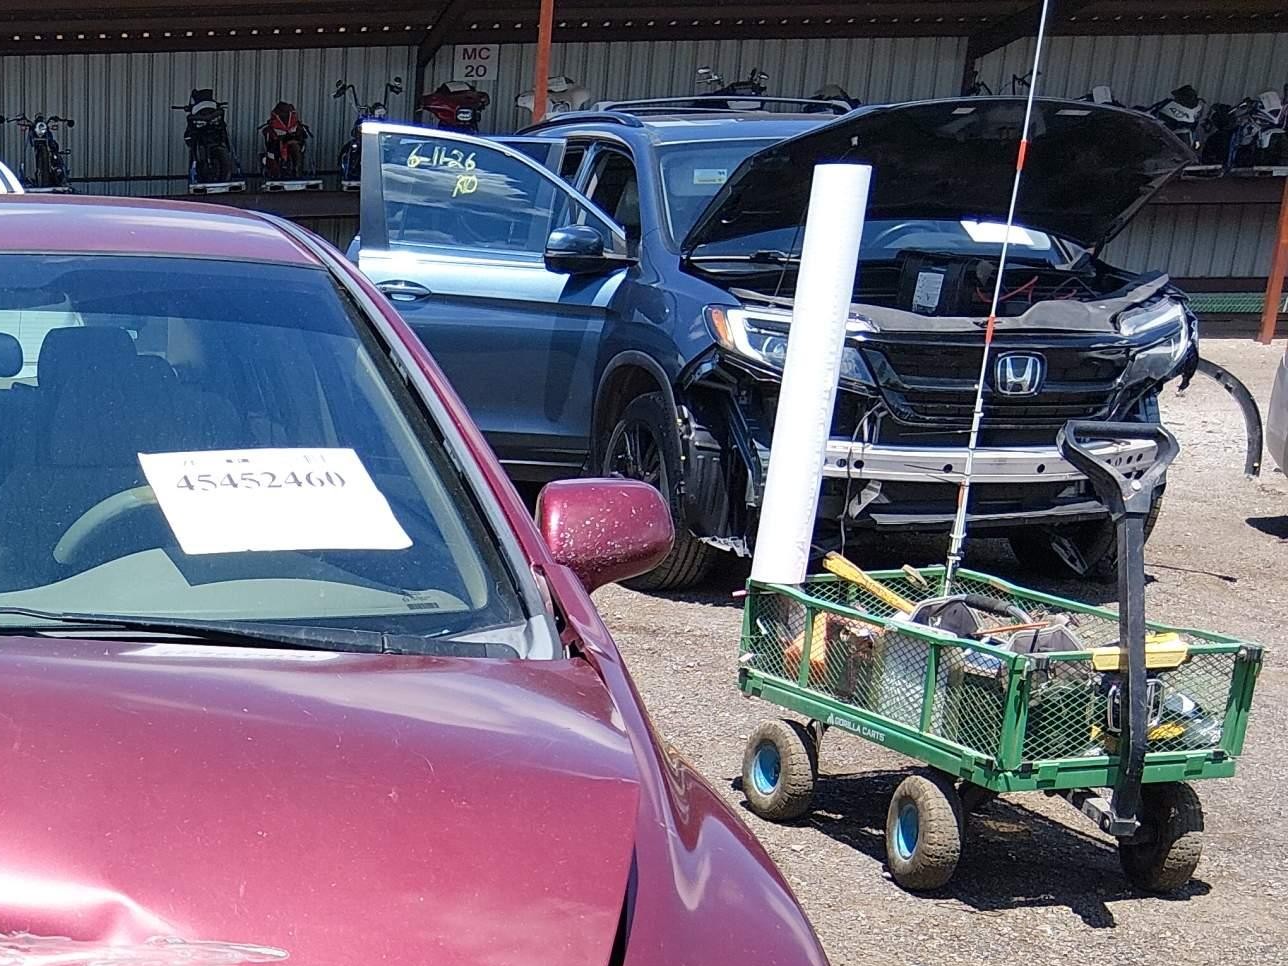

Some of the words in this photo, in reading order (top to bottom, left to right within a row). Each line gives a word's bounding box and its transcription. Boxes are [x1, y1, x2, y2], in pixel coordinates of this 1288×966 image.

[462, 47, 491, 60] MC
[464, 64, 487, 78] 20
[176, 471, 347, 491] 45452460
[834, 716, 861, 734] GORILLA
[862, 726, 886, 742] CARTS
